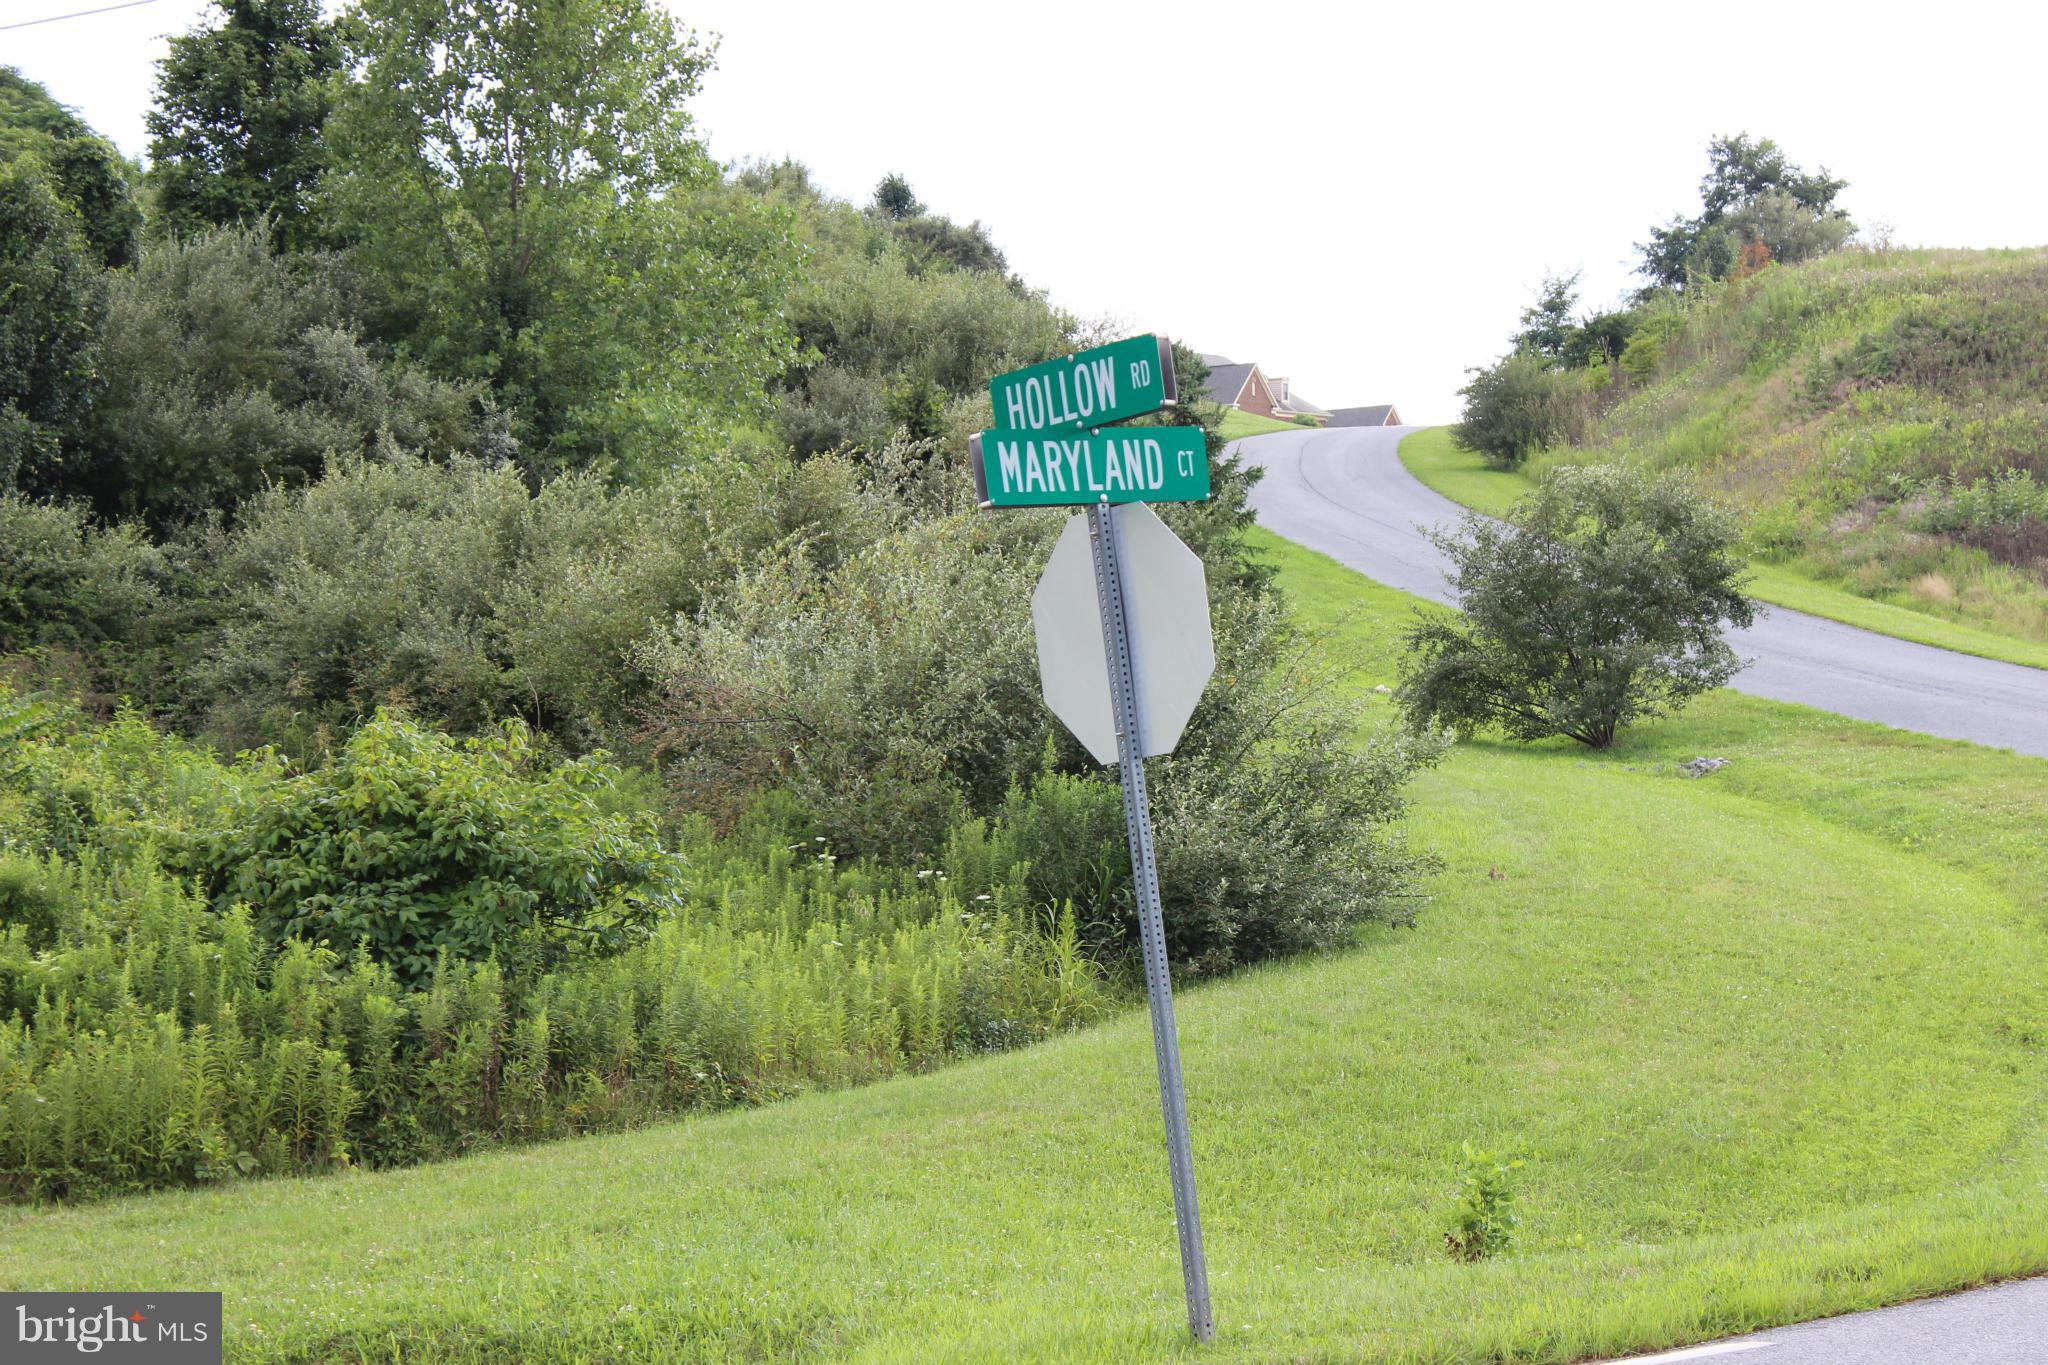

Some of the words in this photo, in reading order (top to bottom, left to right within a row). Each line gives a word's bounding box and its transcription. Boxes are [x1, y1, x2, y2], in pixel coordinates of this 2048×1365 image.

[1005, 356, 1116, 430] HOLLOW
[1130, 359, 1150, 389] RD
[997, 439, 1164, 493] MARYLAND
[1177, 450, 1194, 477] CT
